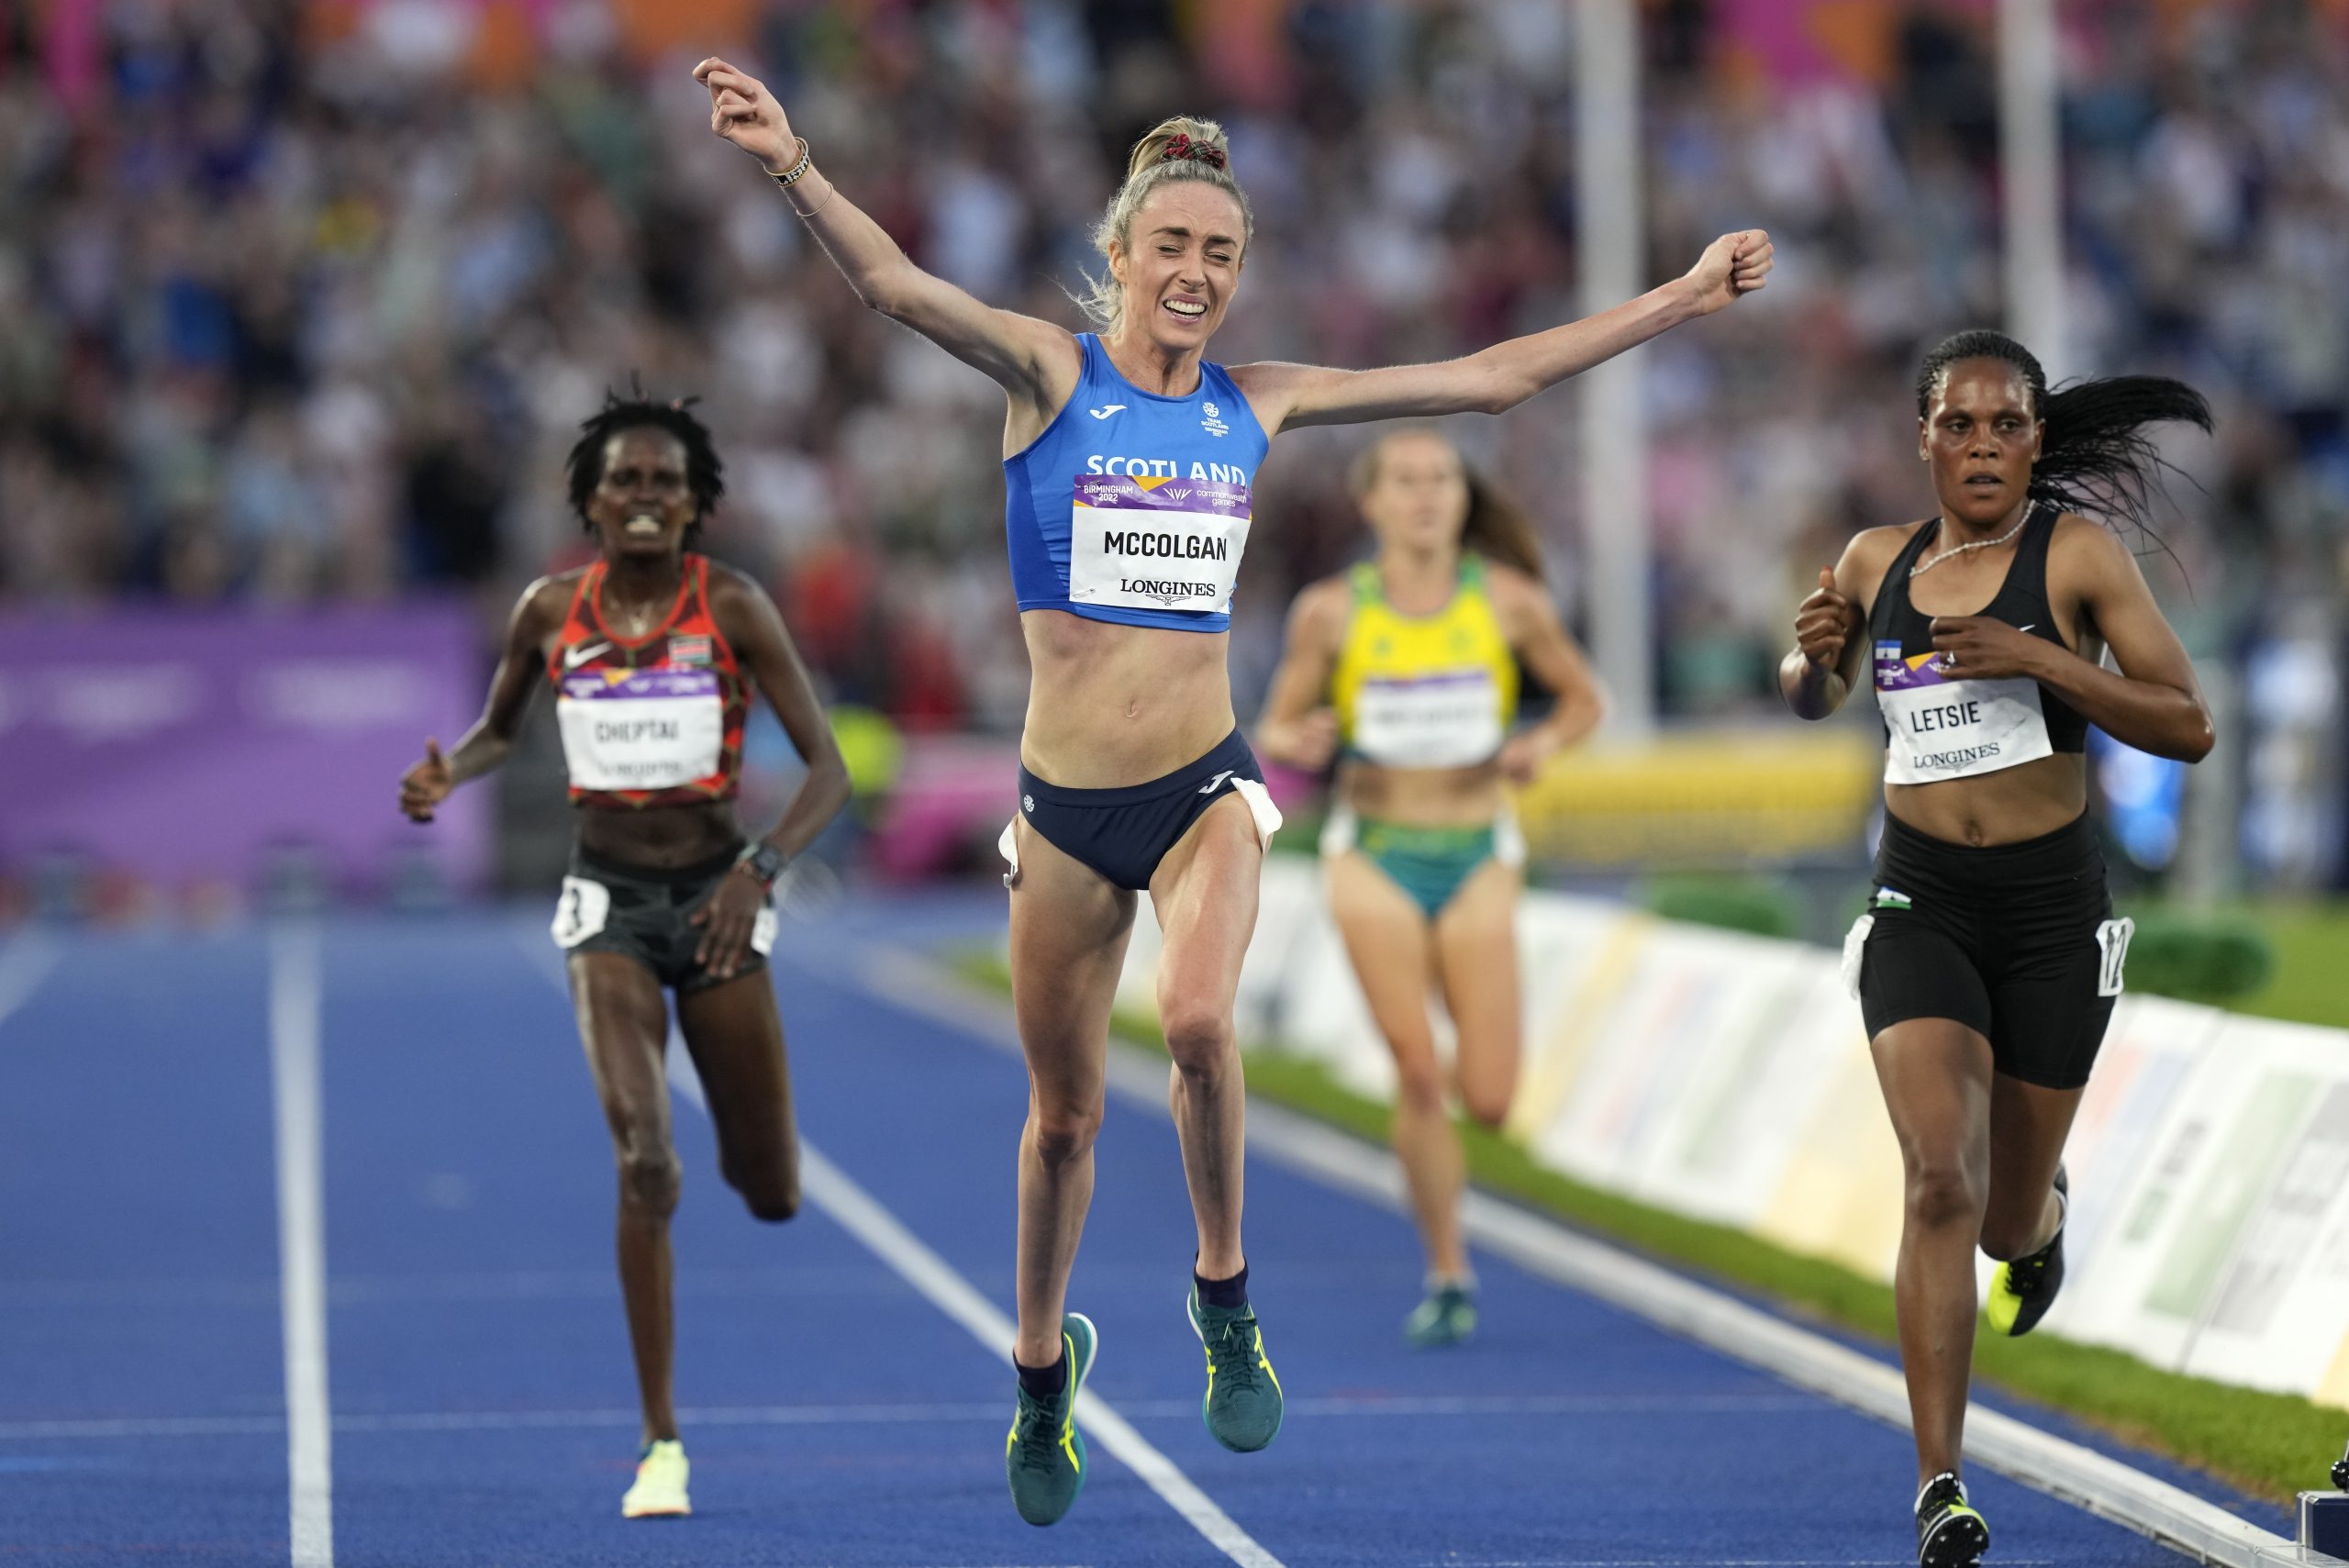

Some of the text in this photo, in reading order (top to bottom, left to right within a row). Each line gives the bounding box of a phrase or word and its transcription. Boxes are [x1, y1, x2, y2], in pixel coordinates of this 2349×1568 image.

[1085, 454, 1247, 486] SCOTLAND
[1084, 484, 1133, 495] BIRMINGHAM
[1098, 493, 1119, 502] 2022
[1197, 488, 1247, 504] commonwealth
[1211, 497, 1236, 507] games
[1104, 530, 1228, 562] MCCOLGAN
[1120, 578, 1217, 597] LONGINES
[1910, 700, 1982, 734] LETSIE
[1913, 741, 2001, 770] LONGINES
